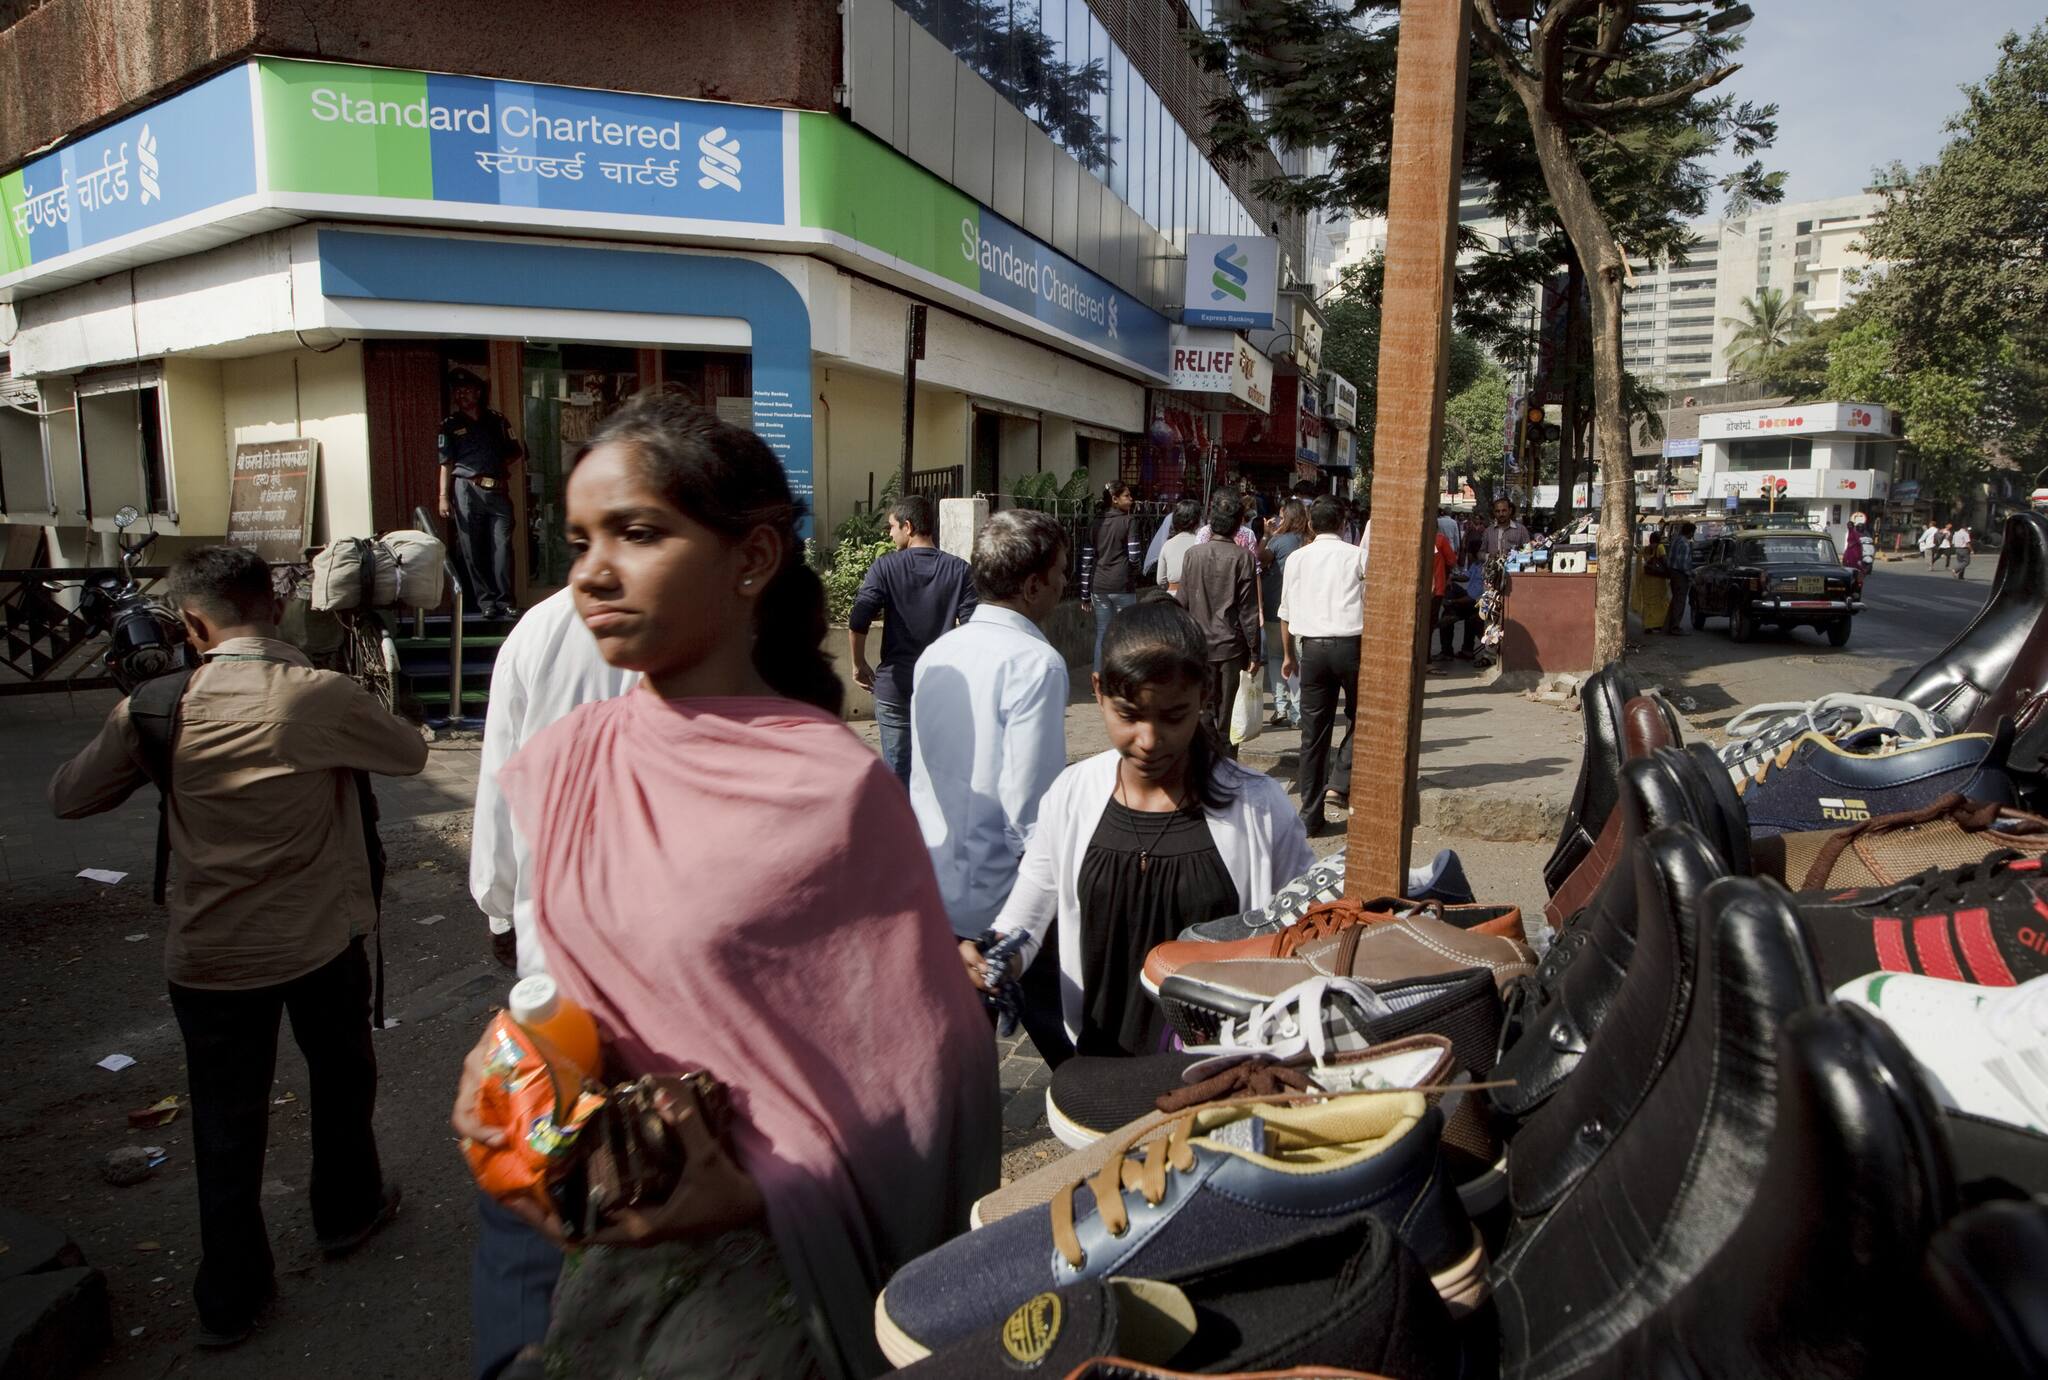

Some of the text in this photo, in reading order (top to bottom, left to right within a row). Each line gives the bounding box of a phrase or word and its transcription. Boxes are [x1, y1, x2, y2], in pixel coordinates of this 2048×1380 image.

[311, 87, 681, 152] Standard Chartered
[76, 142, 129, 213] चार्टर्ड
[599, 156, 680, 189] चार्टर्ड
[960, 217, 1105, 327] Standard Chartered
[1201, 314, 1255, 324] Express Banking
[1174, 349, 1234, 374] RELIEF
[1822, 807, 1871, 822] FLUID
